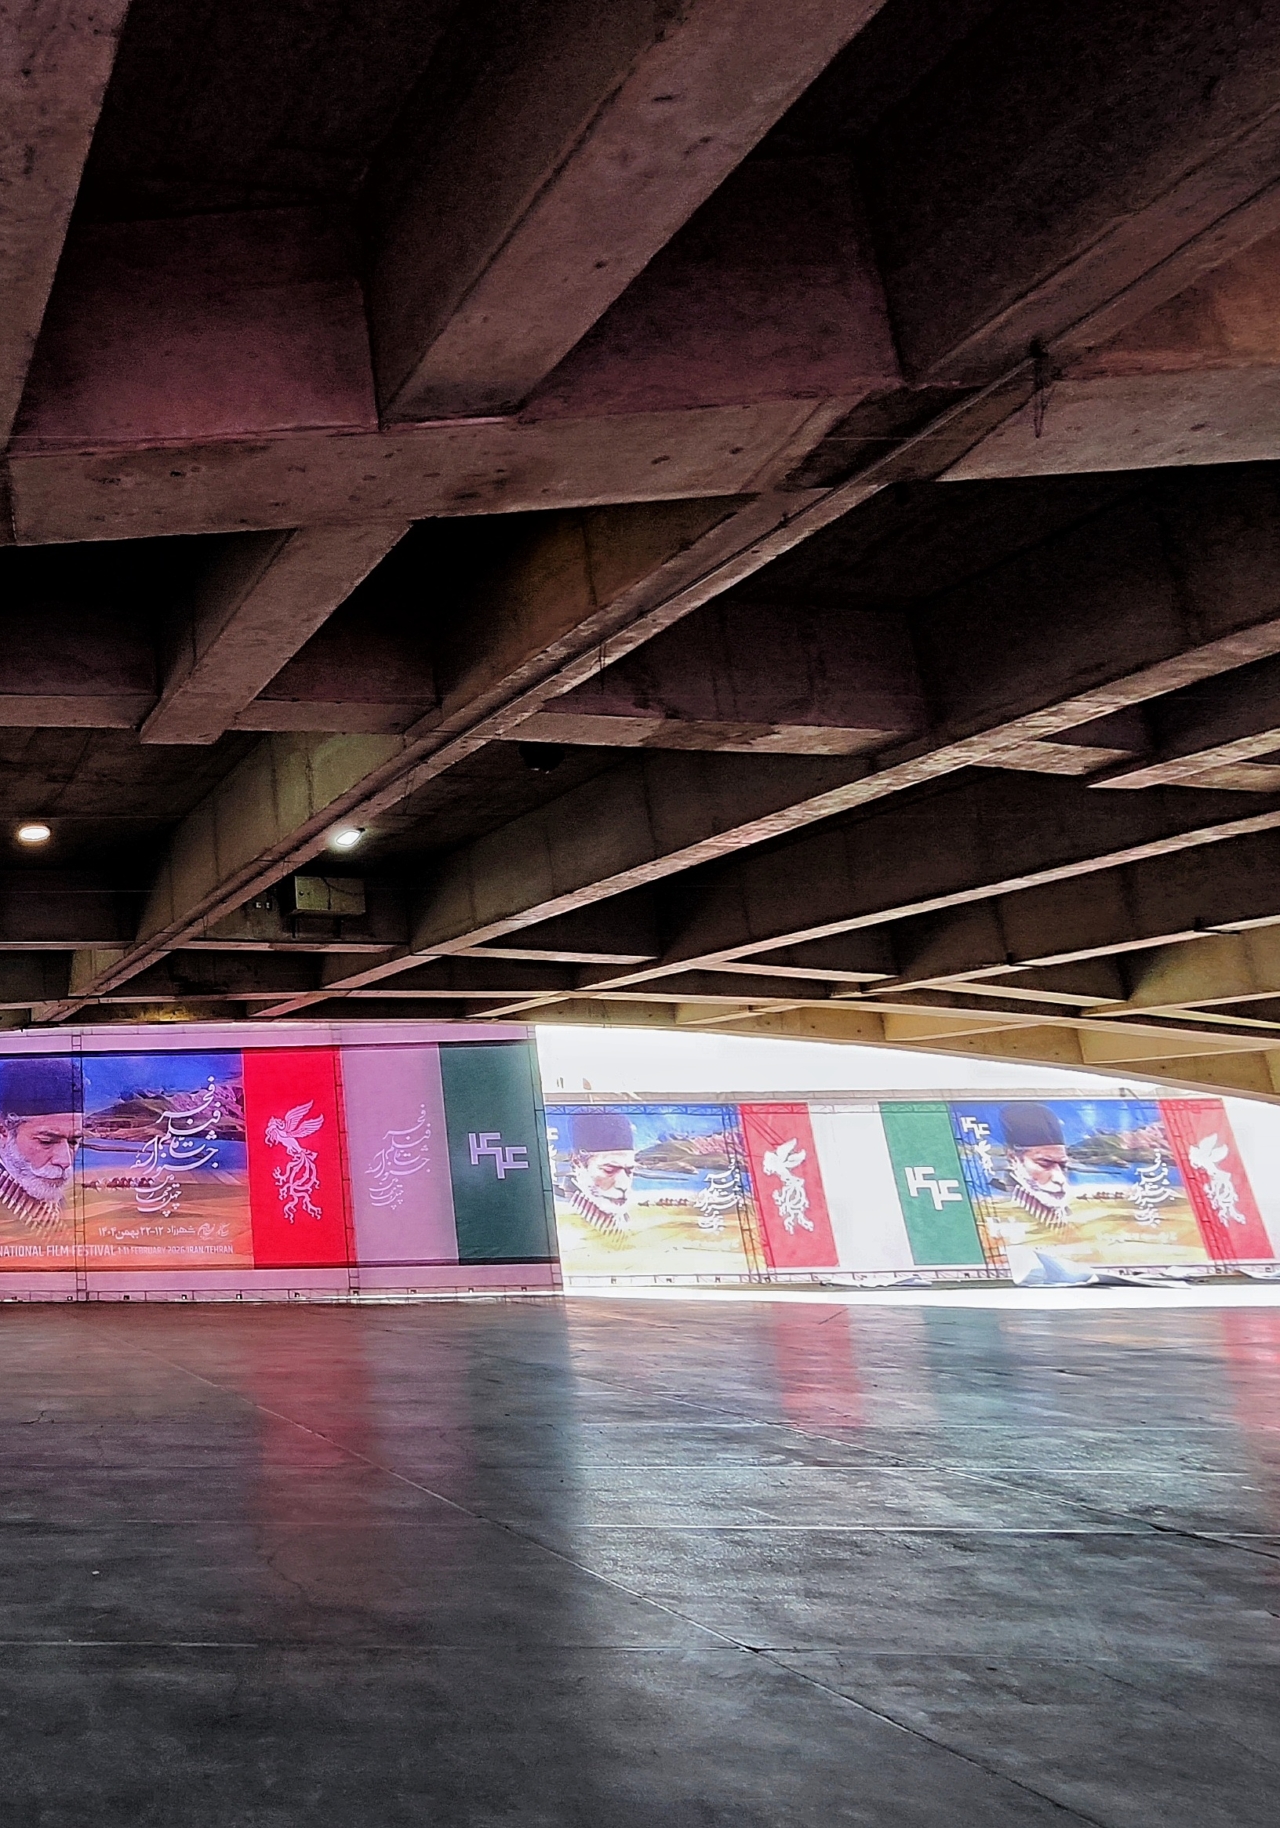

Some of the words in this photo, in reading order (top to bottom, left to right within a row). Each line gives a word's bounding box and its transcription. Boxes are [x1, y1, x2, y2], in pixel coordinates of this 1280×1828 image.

[156, 1076, 215, 1124] فجر
[159, 1102, 221, 1150] فیلم
[115, 1229, 139, 1240] بهمن
[47, 1245, 69, 1257] FILM
[72, 1244, 115, 1256] FESTIVAL
[131, 1246, 166, 1255] FEBRUARY
